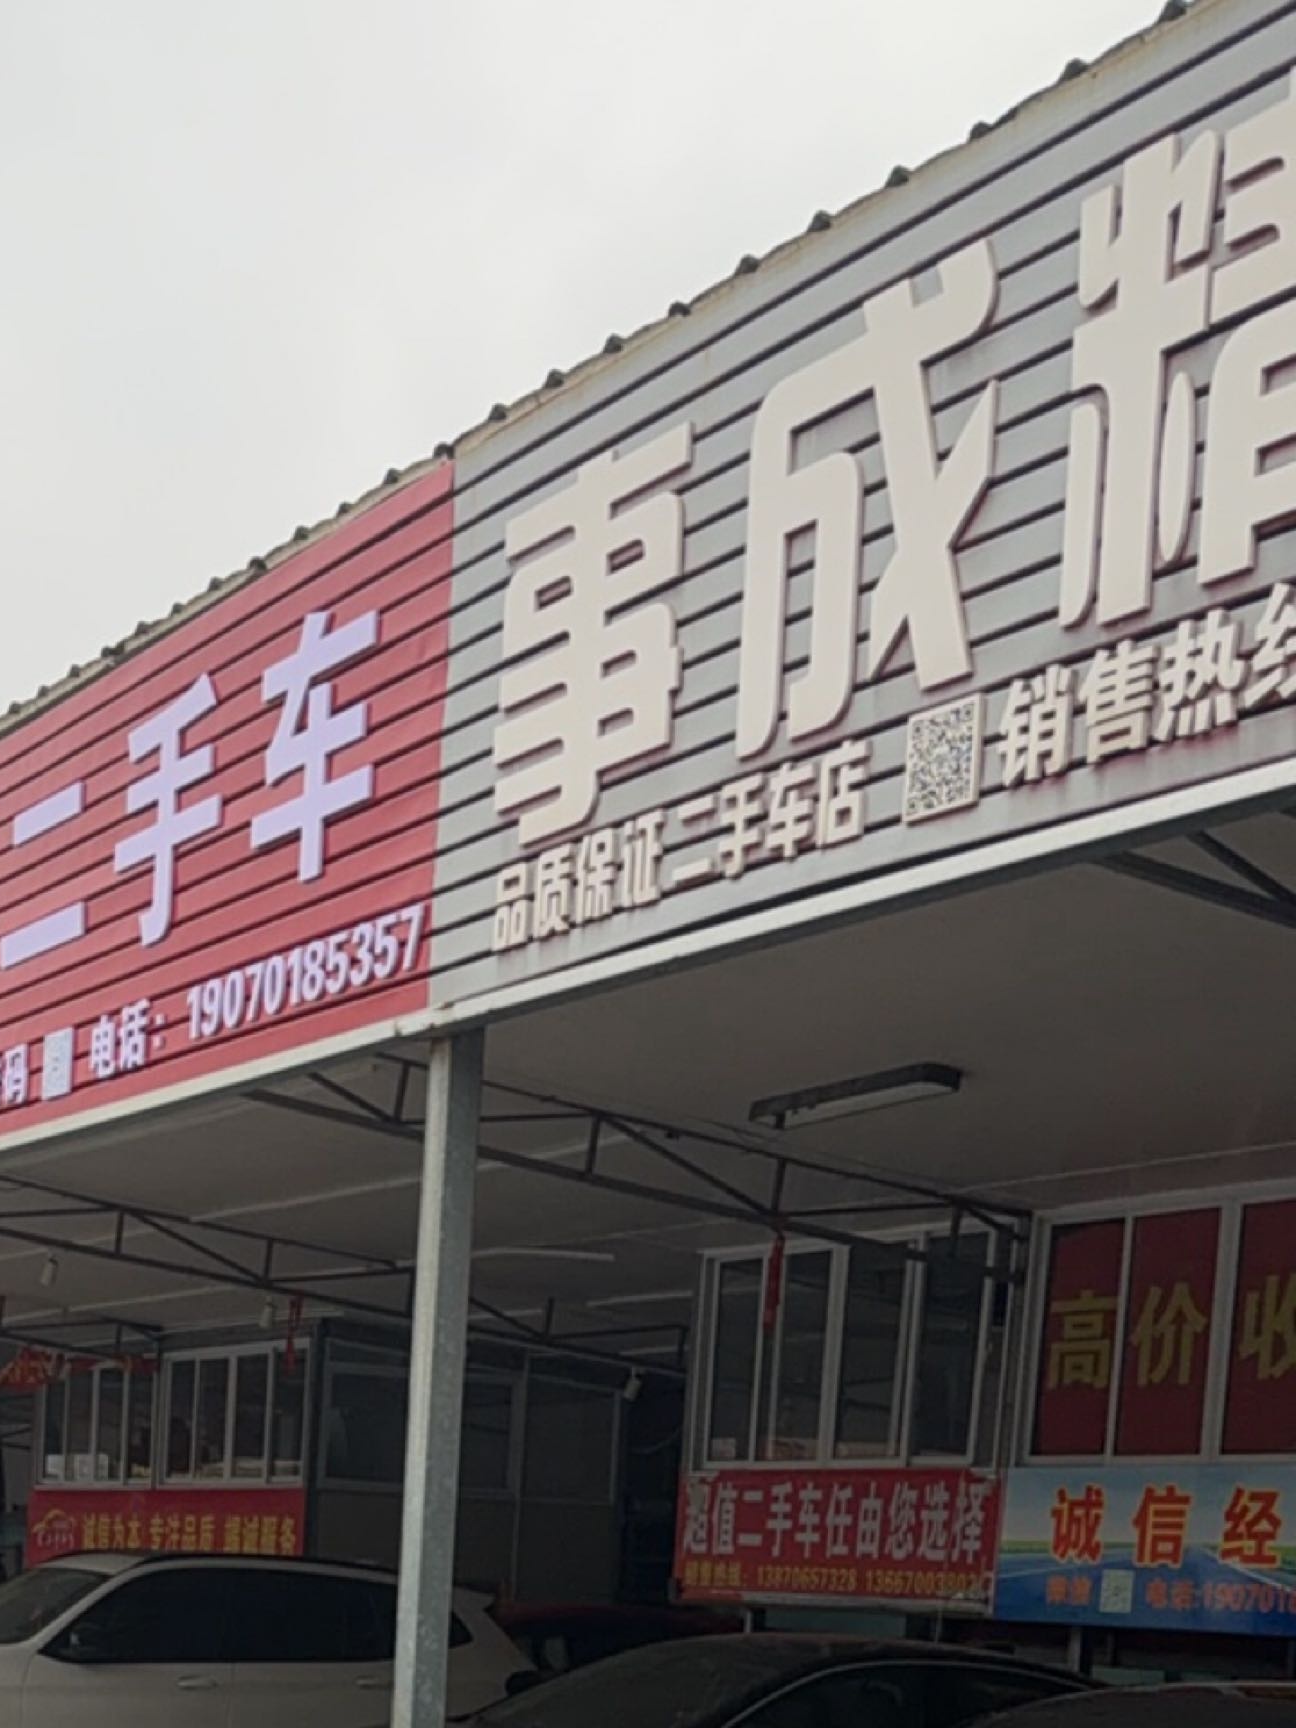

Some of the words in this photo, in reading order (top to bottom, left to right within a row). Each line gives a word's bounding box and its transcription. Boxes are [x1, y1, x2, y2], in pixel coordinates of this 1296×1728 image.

[494, 65, 1296, 848] 事成精
[490, 739, 871, 951] 品质保证二手车店
[1048, 1275, 1296, 1389] 高价收
[682, 1479, 991, 1563] 超值二手车任由您选择
[1050, 1483, 1283, 1568] 诚信经
